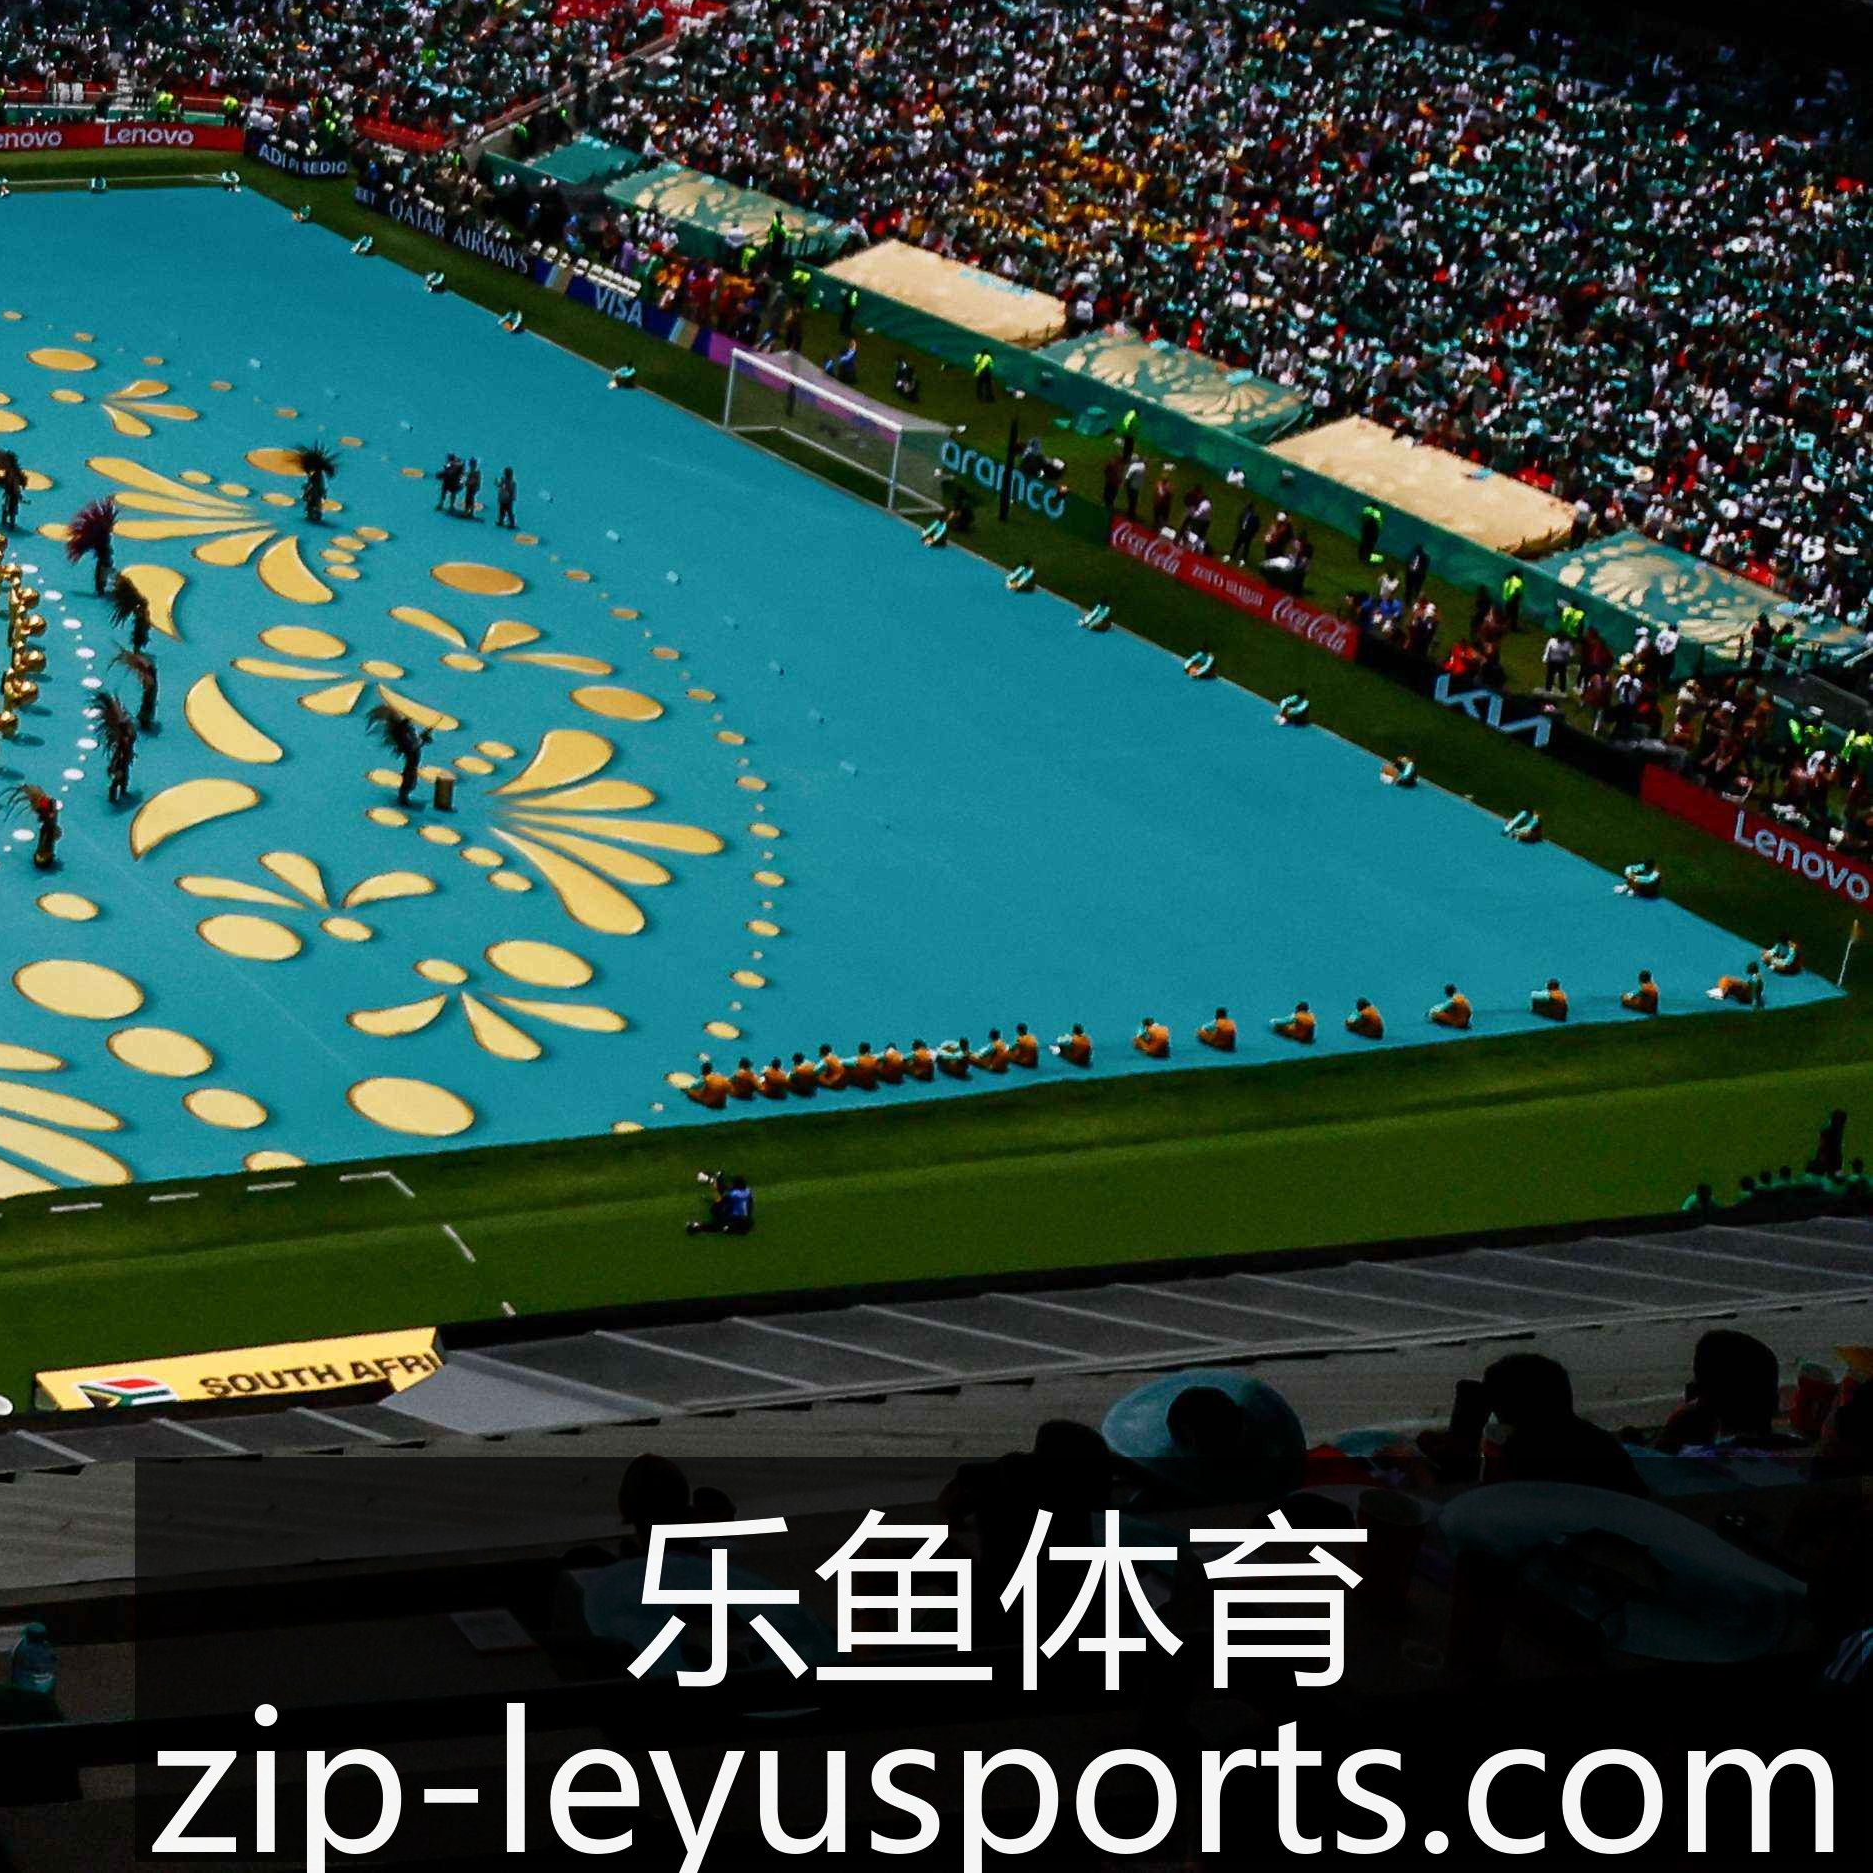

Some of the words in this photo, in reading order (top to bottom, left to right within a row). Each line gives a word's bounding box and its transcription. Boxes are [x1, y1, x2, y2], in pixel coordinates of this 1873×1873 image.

[103, 122, 194, 147] Lenovo
[594, 283, 645, 330] VISA
[940, 438, 1069, 521] aramco
[1433, 673, 1552, 749] KIA
[1733, 810, 1870, 904] Lenovo
[200, 1363, 343, 1399] SOUTH
[349, 1353, 440, 1381] AFRI
